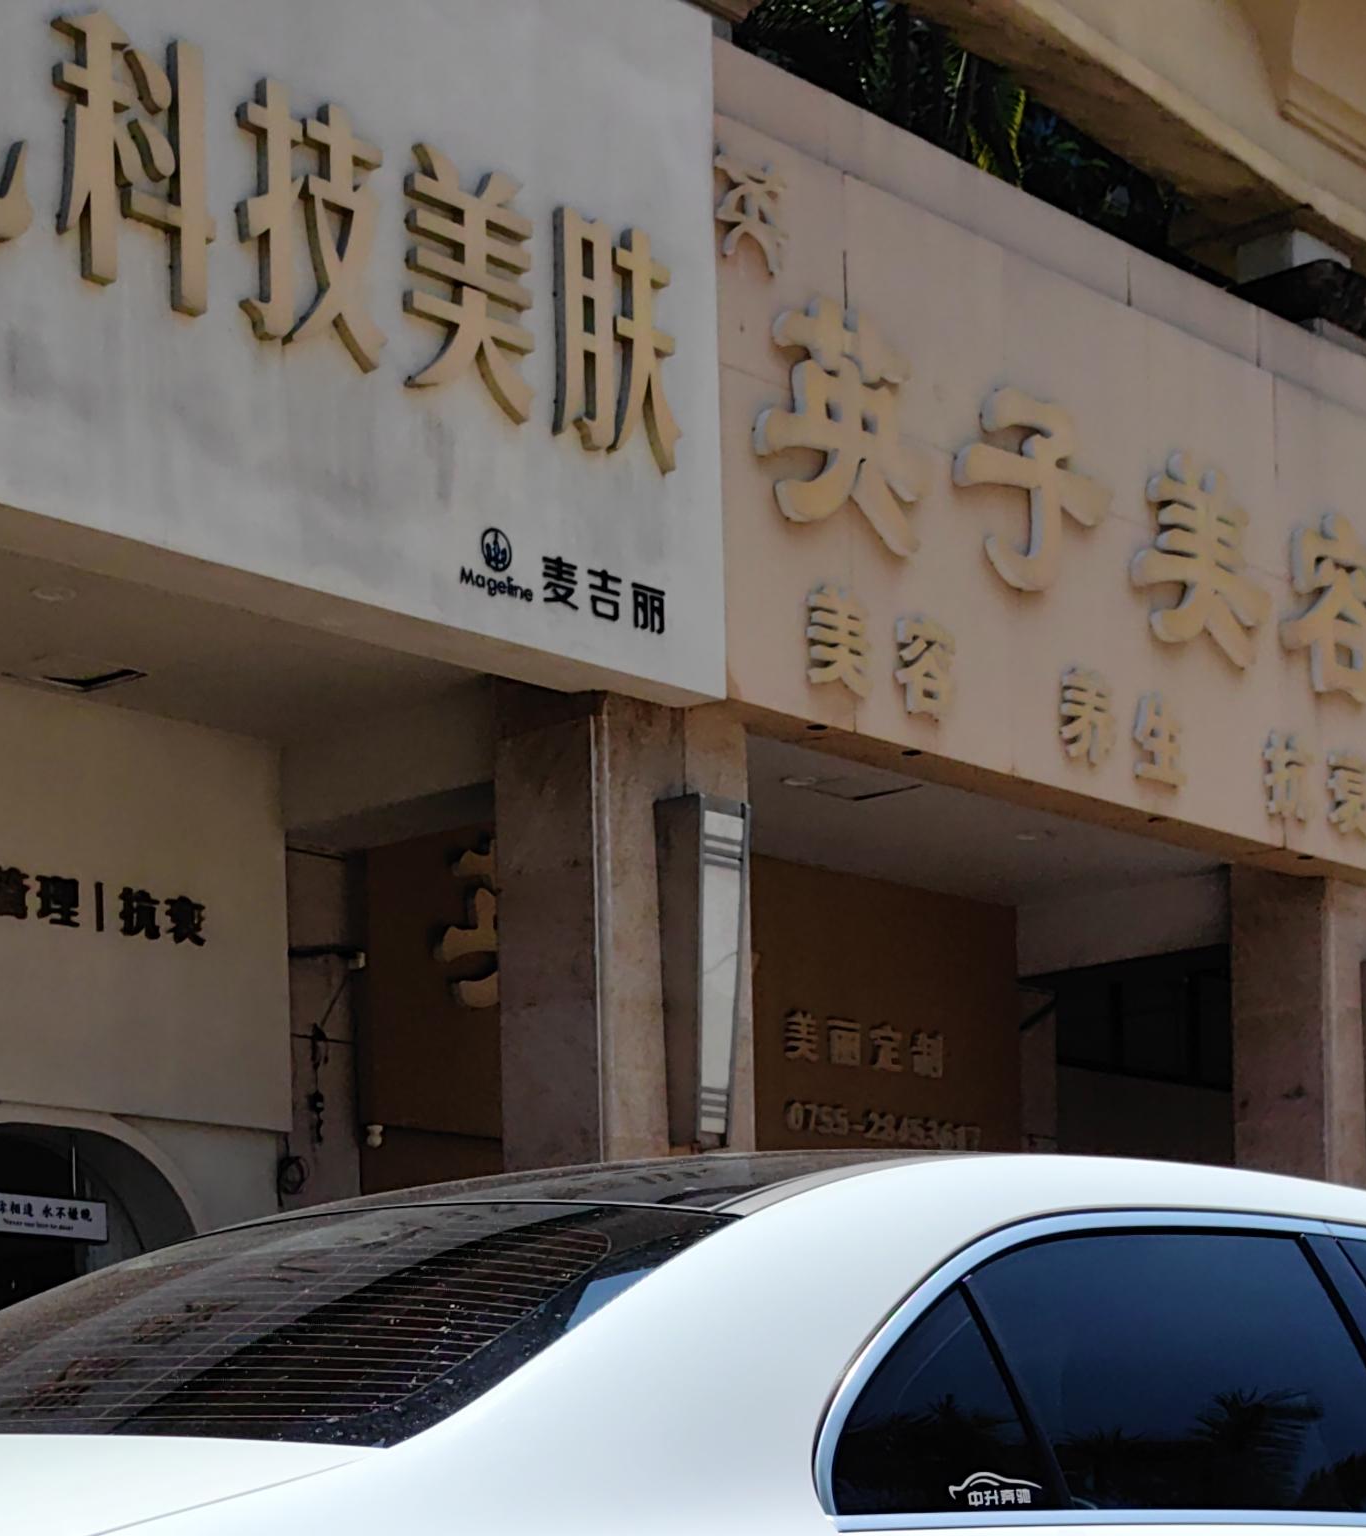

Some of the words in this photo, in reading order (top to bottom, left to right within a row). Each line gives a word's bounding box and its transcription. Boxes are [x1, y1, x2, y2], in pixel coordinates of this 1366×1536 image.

[459, 566, 534, 603] Mageline
[541, 555, 666, 635] 麦吉丽
[805, 582, 955, 721] 美容
[1058, 664, 1186, 792] 养生
